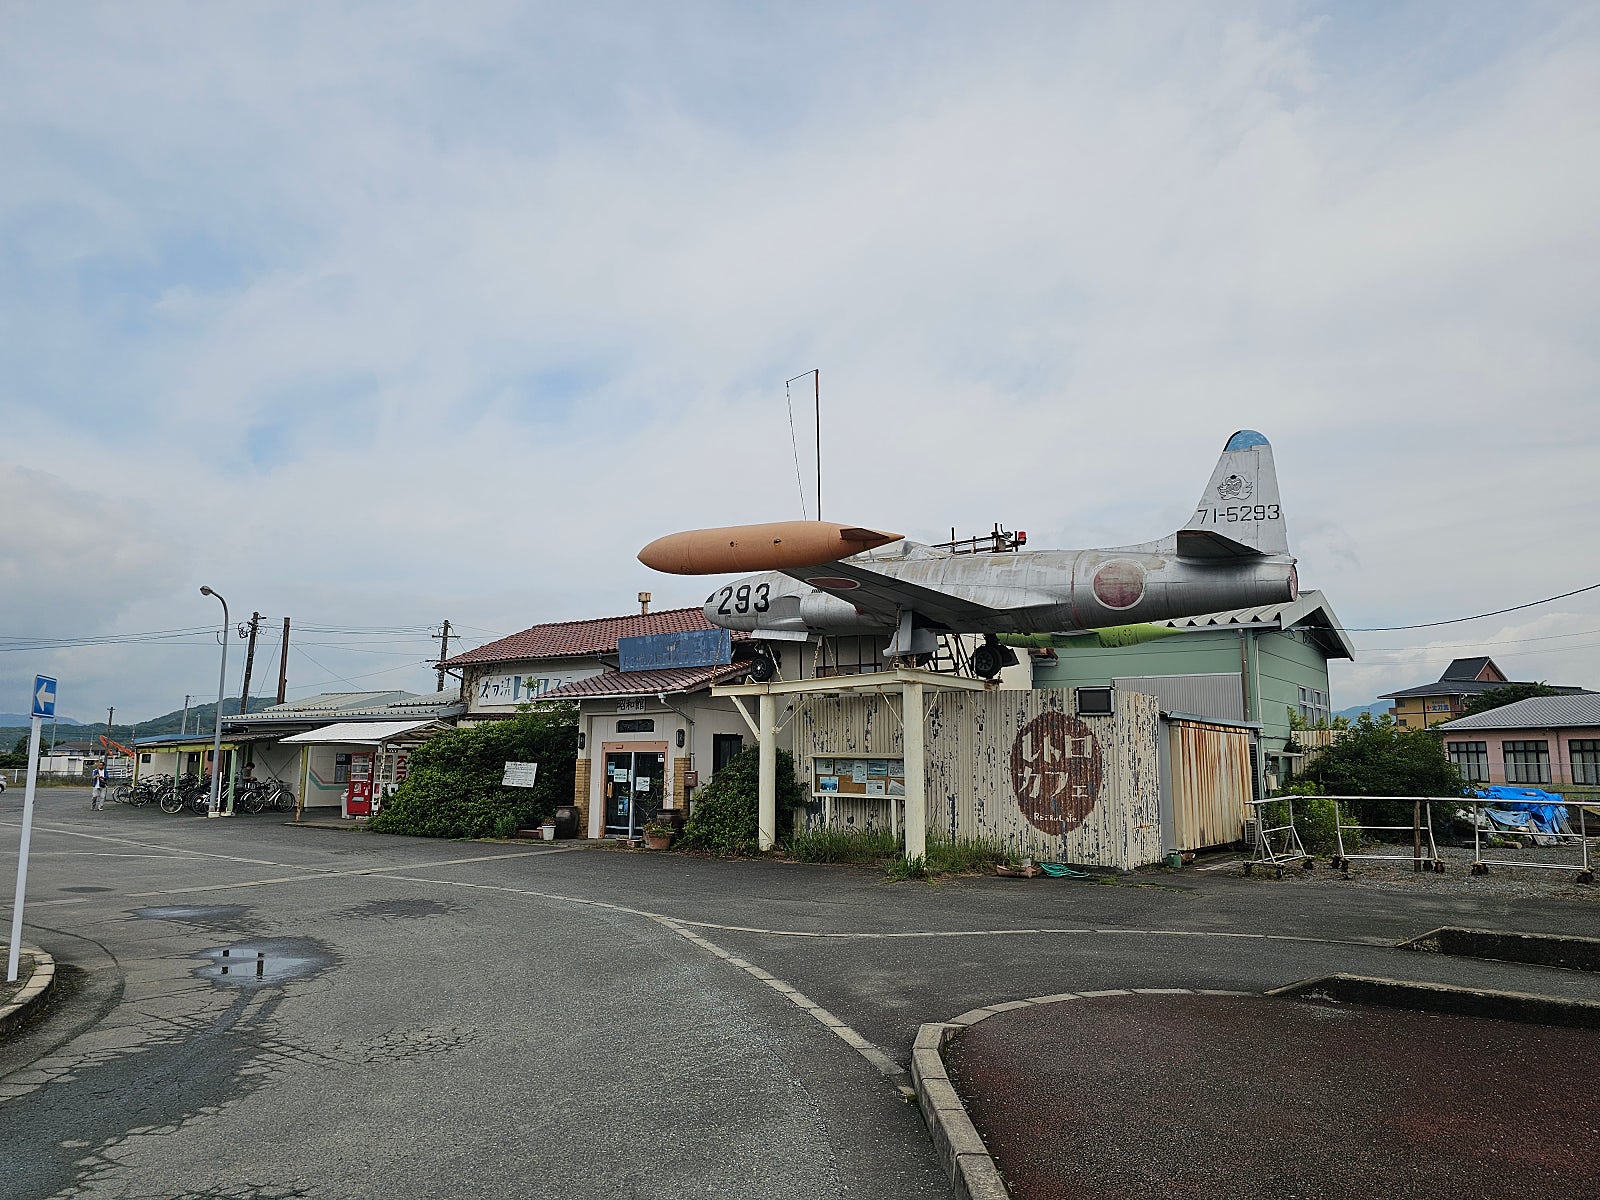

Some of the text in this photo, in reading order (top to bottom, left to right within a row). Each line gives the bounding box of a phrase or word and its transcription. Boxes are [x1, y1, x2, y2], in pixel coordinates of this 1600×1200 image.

[1197, 504, 1280, 525] 71-5293
[718, 583, 770, 615] 293
[1021, 731, 1093, 763] レトロ
[1017, 765, 1089, 798] カフェ
